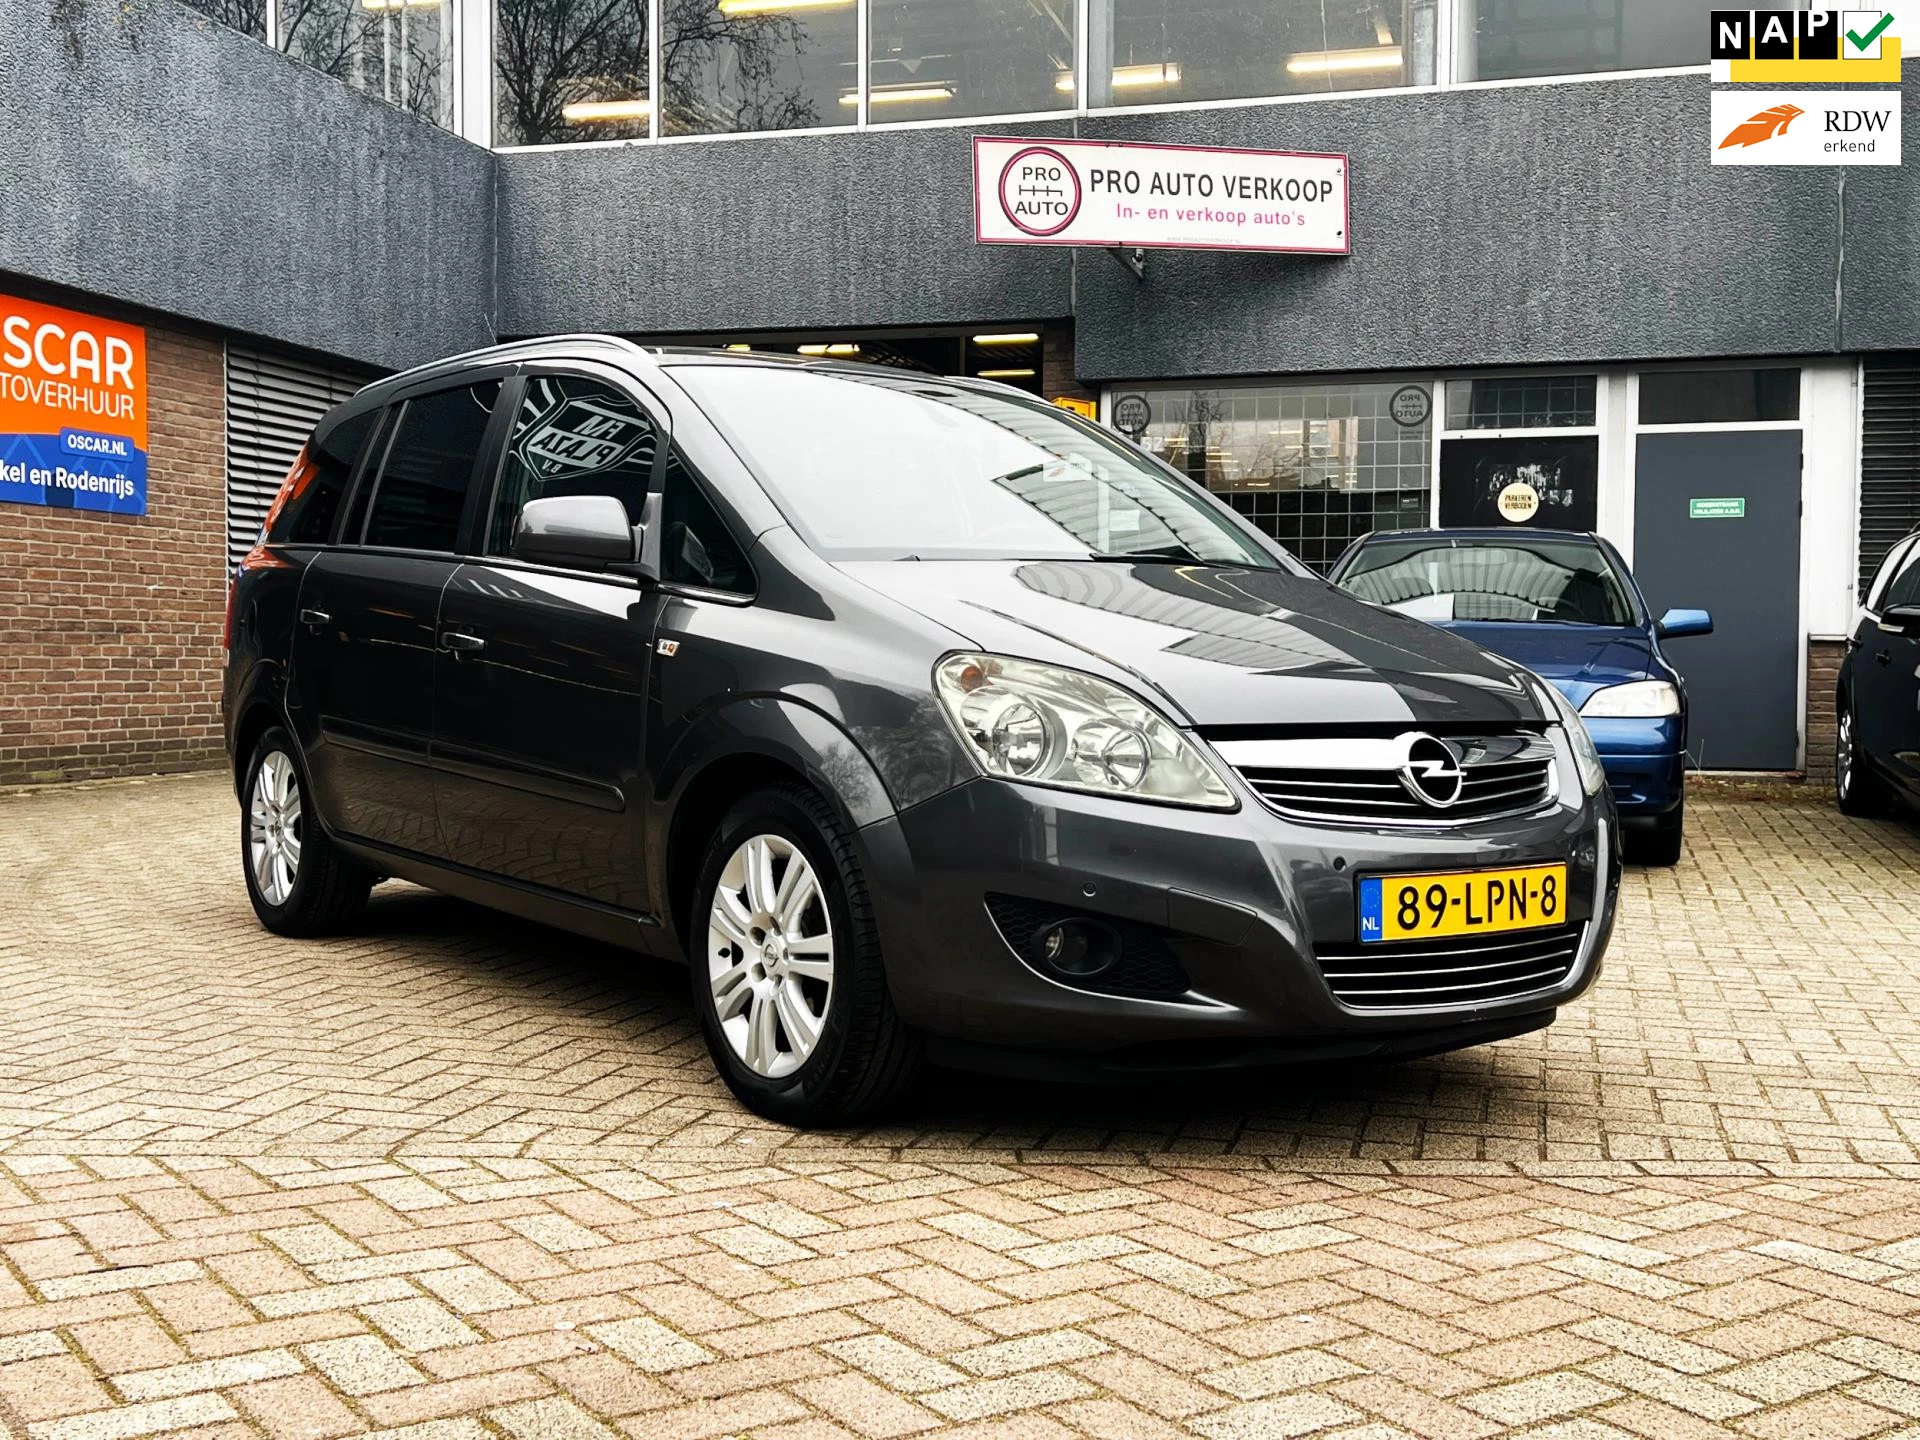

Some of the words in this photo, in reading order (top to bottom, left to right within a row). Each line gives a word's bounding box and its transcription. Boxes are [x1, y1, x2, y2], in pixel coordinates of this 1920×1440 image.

[1022, 166, 1061, 182] PRO
[1090, 169, 1140, 194] PRO
[1150, 172, 1213, 197] AUTO
[1222, 175, 1333, 203] VERKOOP
[1014, 201, 1068, 216] AUTO
[1116, 203, 1140, 218] In-
[1147, 208, 1169, 221] en
[1177, 206, 1246, 226] verkoop
[1254, 210, 1305, 226] auto's
[3, 316, 134, 390] SCAR
[0, 372, 135, 421] TOVERHUUR
[67, 434, 127, 457] OSCAR.NL
[30, 469, 51, 487] en
[55, 467, 134, 500] Rodenrijs
[1397, 874, 1557, 930] 89-LPN-8
[1362, 917, 1379, 931] NL
